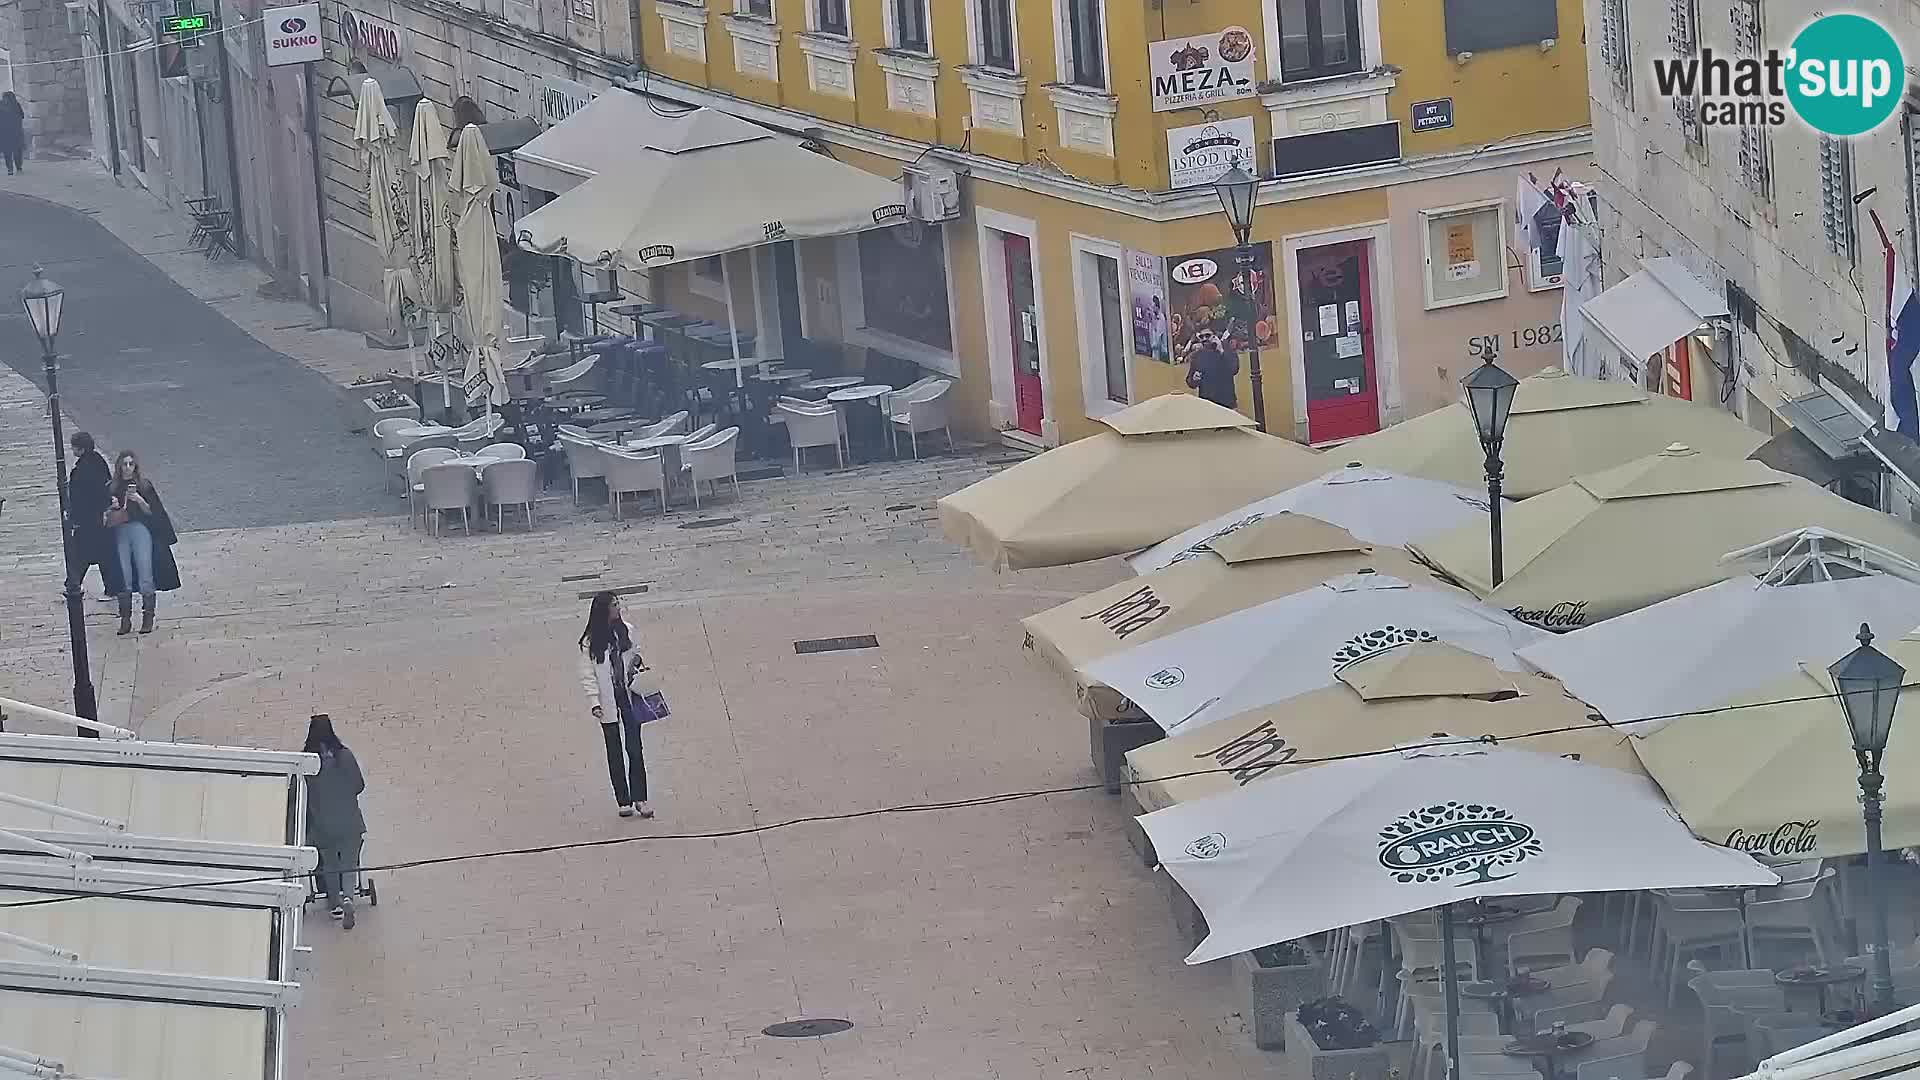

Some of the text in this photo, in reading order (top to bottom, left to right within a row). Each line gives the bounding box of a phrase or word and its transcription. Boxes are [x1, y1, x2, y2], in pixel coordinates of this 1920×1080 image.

[272, 35, 318, 49] SUKNO
[359, 20, 399, 60] SUKNO
[1155, 66, 1234, 97] MEZA
[1165, 94, 1197, 105] PIZZERIA
[1205, 90, 1225, 99] GRILL
[1173, 152, 1219, 170] ISPOD
[1512, 324, 1563, 349] 1982
[1418, 826, 1517, 857] RAUCH
[1724, 819, 1820, 856] Coca-Cola
